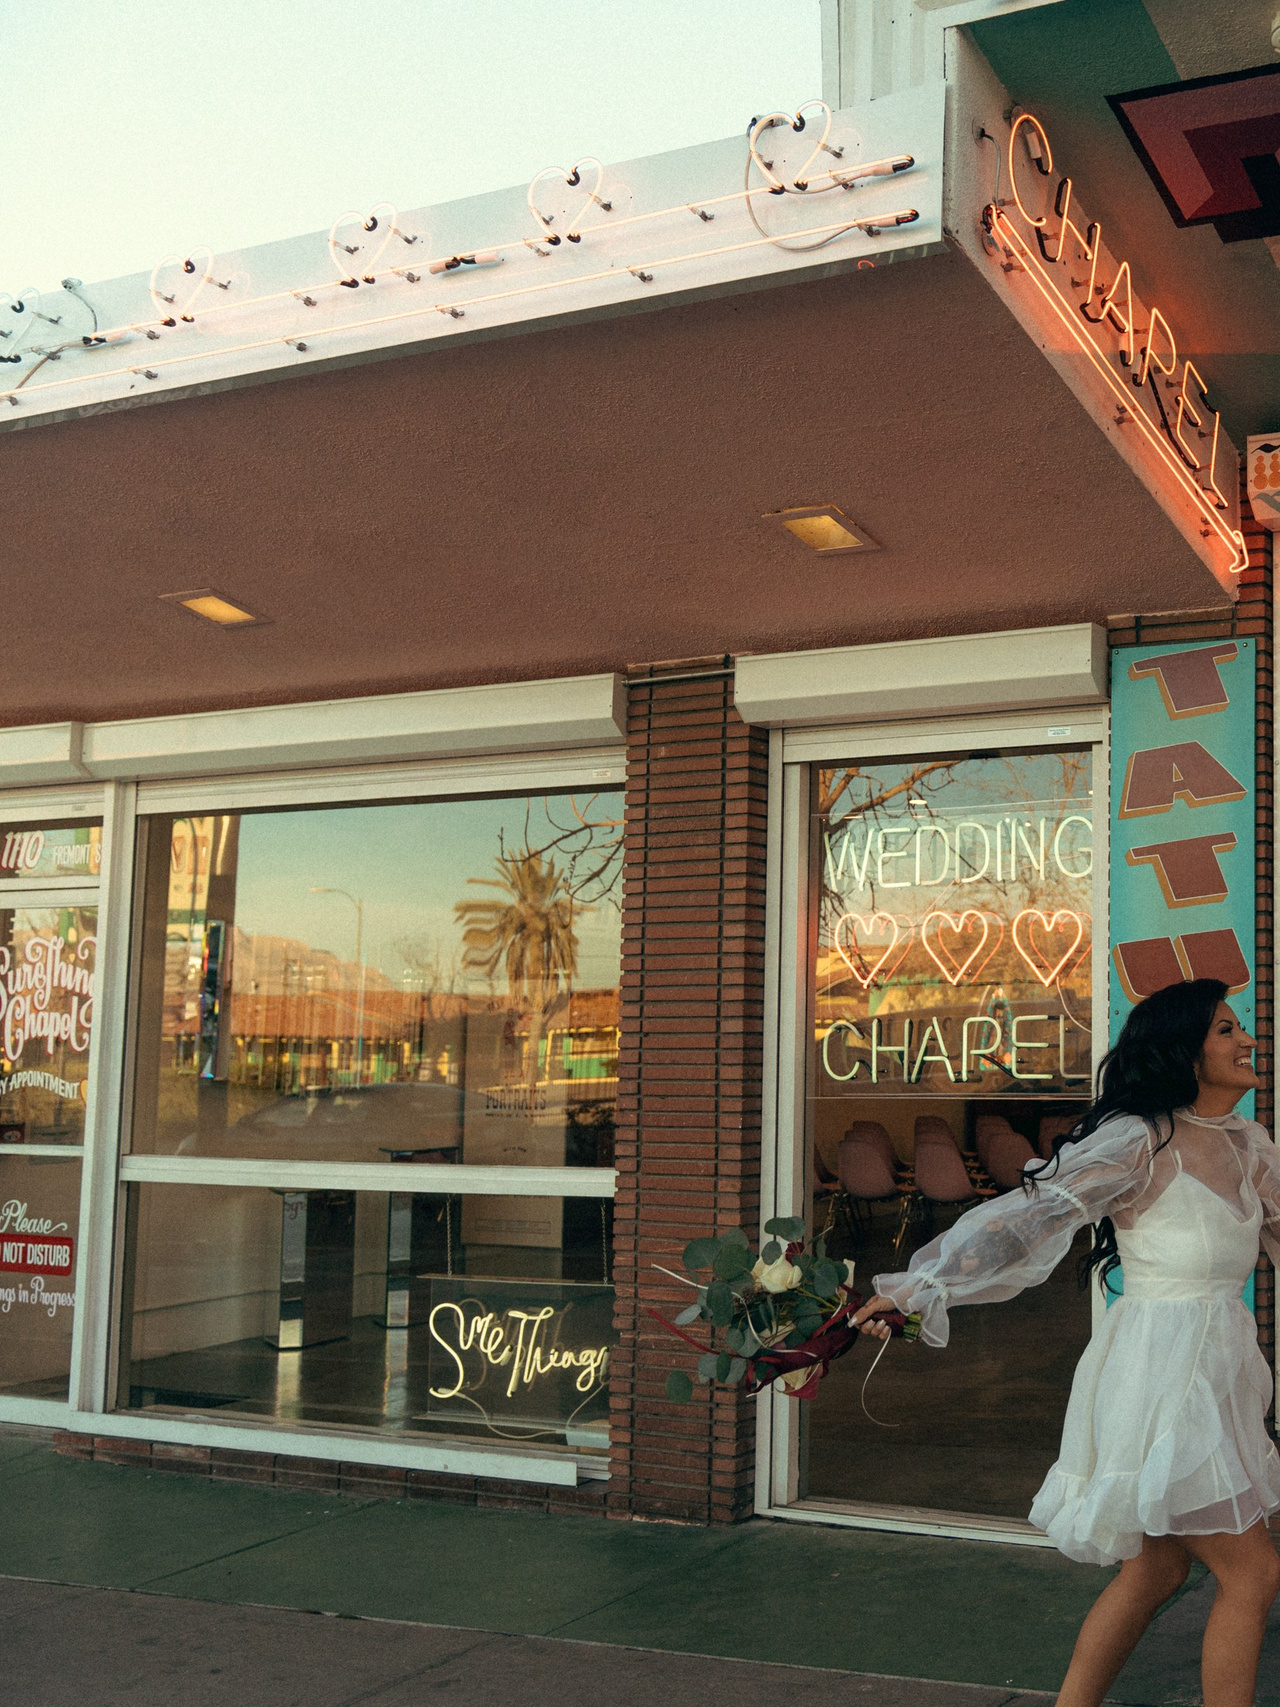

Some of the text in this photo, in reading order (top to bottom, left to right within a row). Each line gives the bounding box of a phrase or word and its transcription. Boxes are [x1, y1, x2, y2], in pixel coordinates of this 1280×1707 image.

[1007, 112, 1229, 510] CHAPEL
[53, 843, 90, 865] FREMONT
[822, 815, 1093, 892] WEDDING
[4, 994, 90, 1061] Chapel
[822, 1014, 1093, 1084] CHAPEL
[9, 1071, 80, 1099] APPOINTMENT
[0, 1199, 68, 1234] Please
[2, 1241, 70, 1268] NOT DISTURB
[18, 1283, 29, 1304] in
